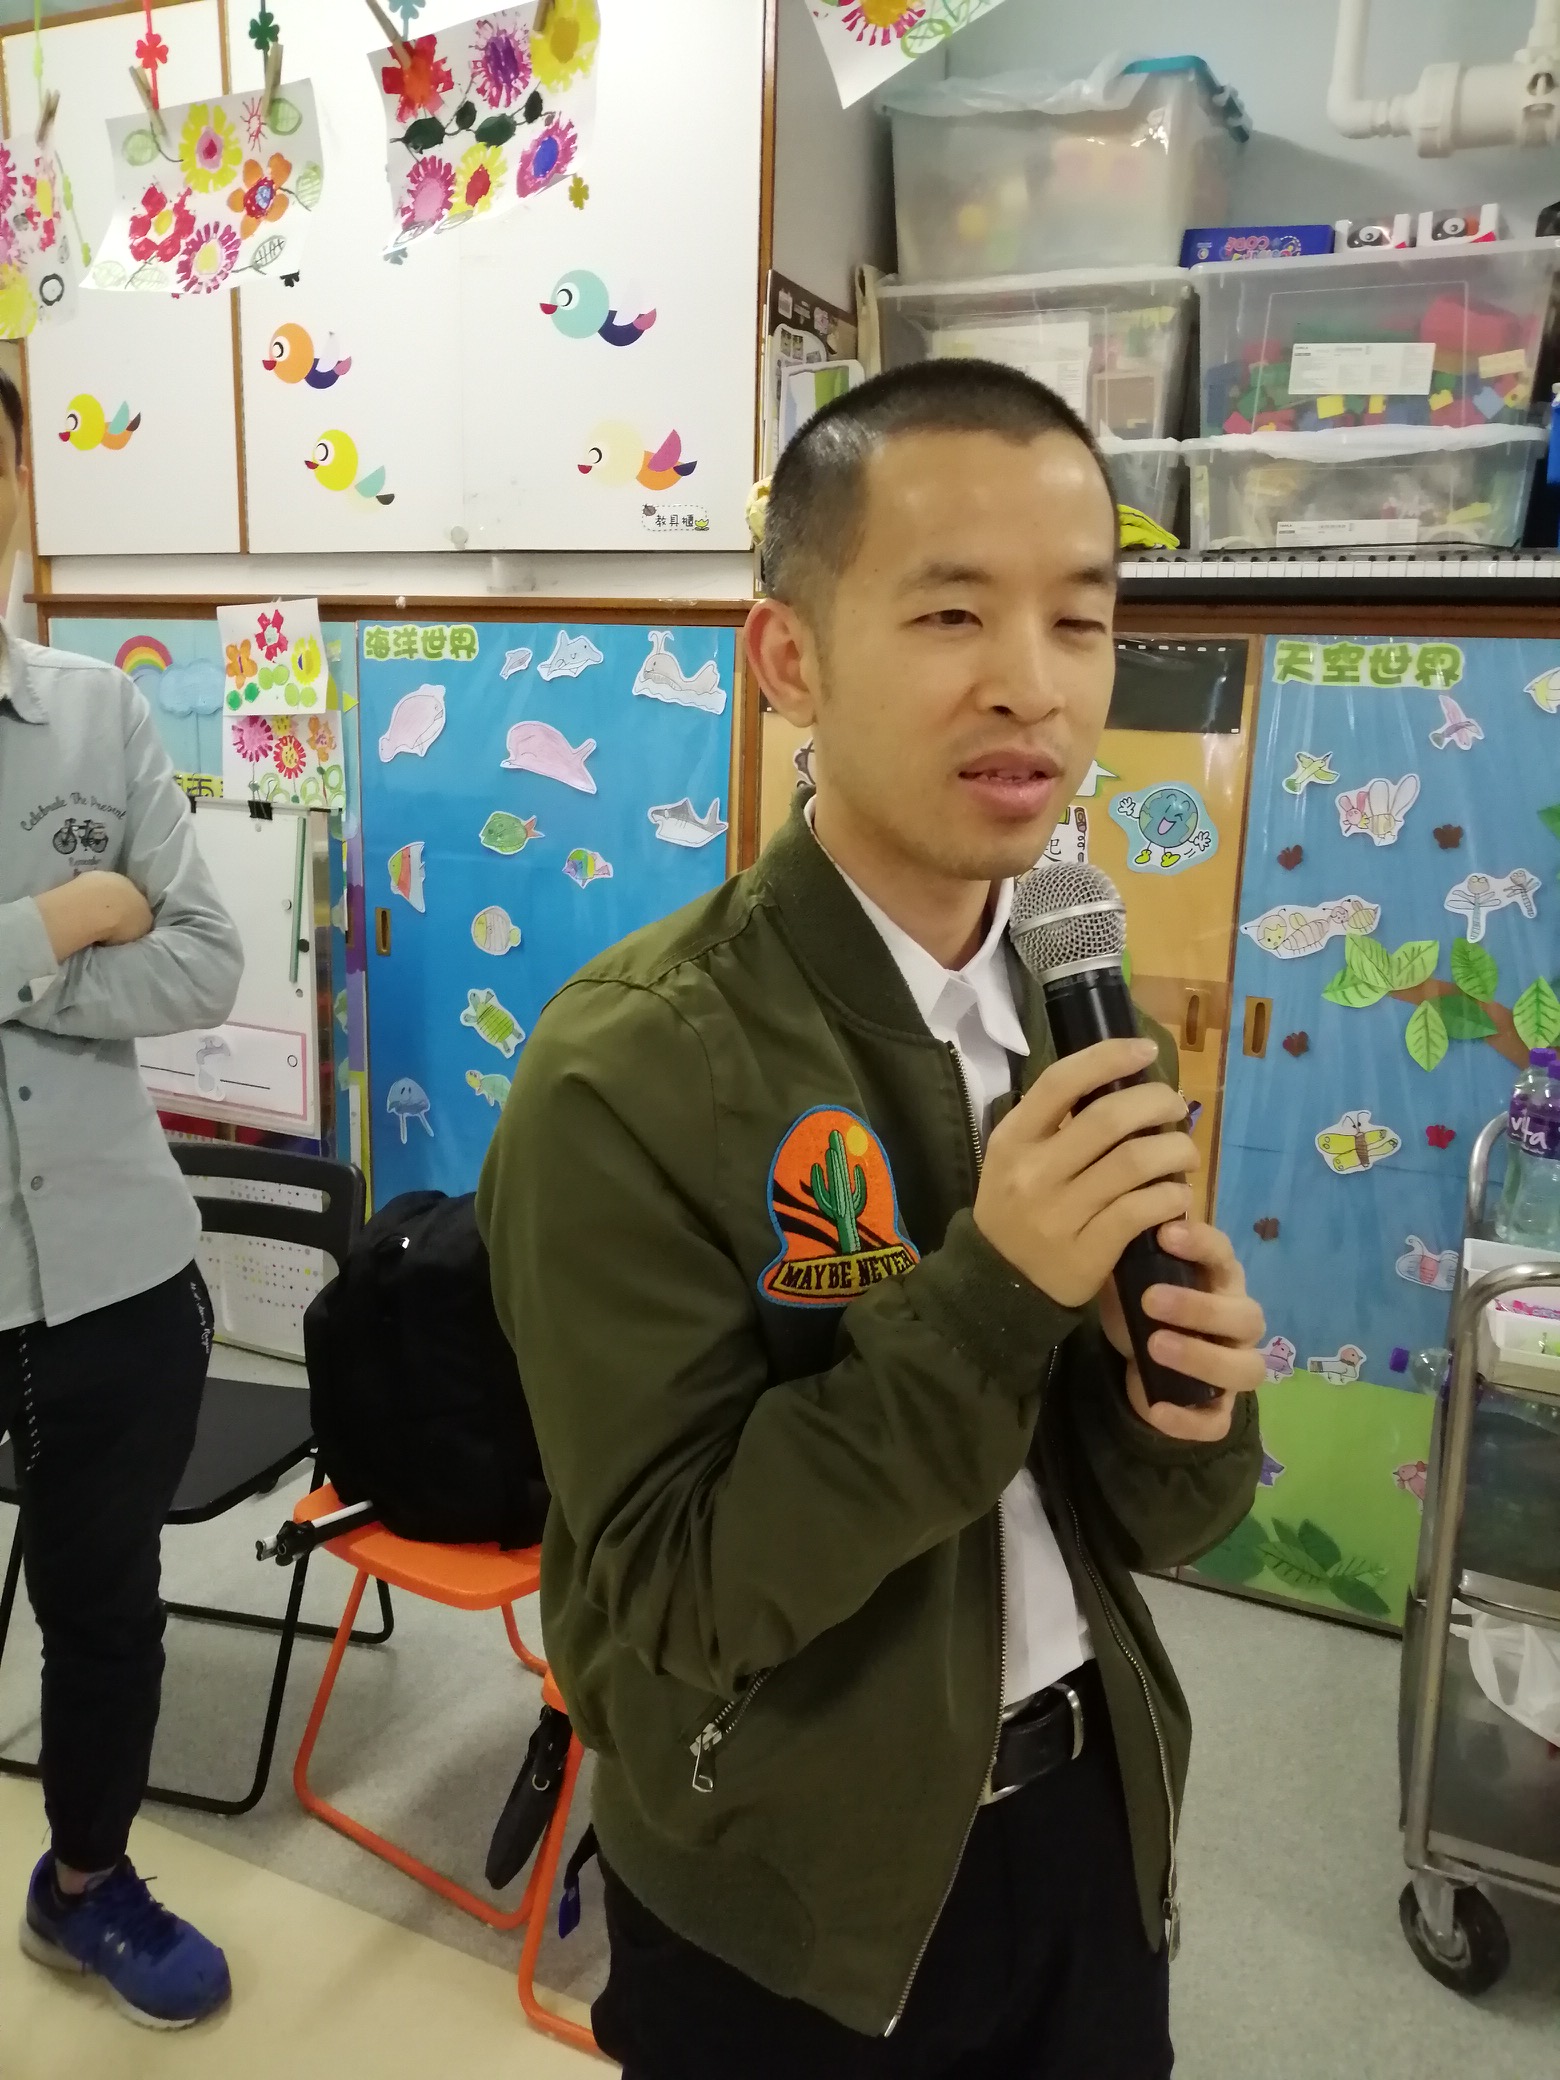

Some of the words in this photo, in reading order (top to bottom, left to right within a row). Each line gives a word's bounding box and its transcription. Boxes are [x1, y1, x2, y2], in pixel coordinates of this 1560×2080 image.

[655, 514, 694, 527] 教具櫃
[365, 626, 477, 659] 海洋世界
[1276, 641, 1461, 688] 天空世界
[20, 795, 67, 832] Celebrate
[69, 791, 88, 806] The
[90, 795, 127, 820] Present
[780, 1261, 852, 1290] MAYBE
[856, 1251, 916, 1288] NEVER
